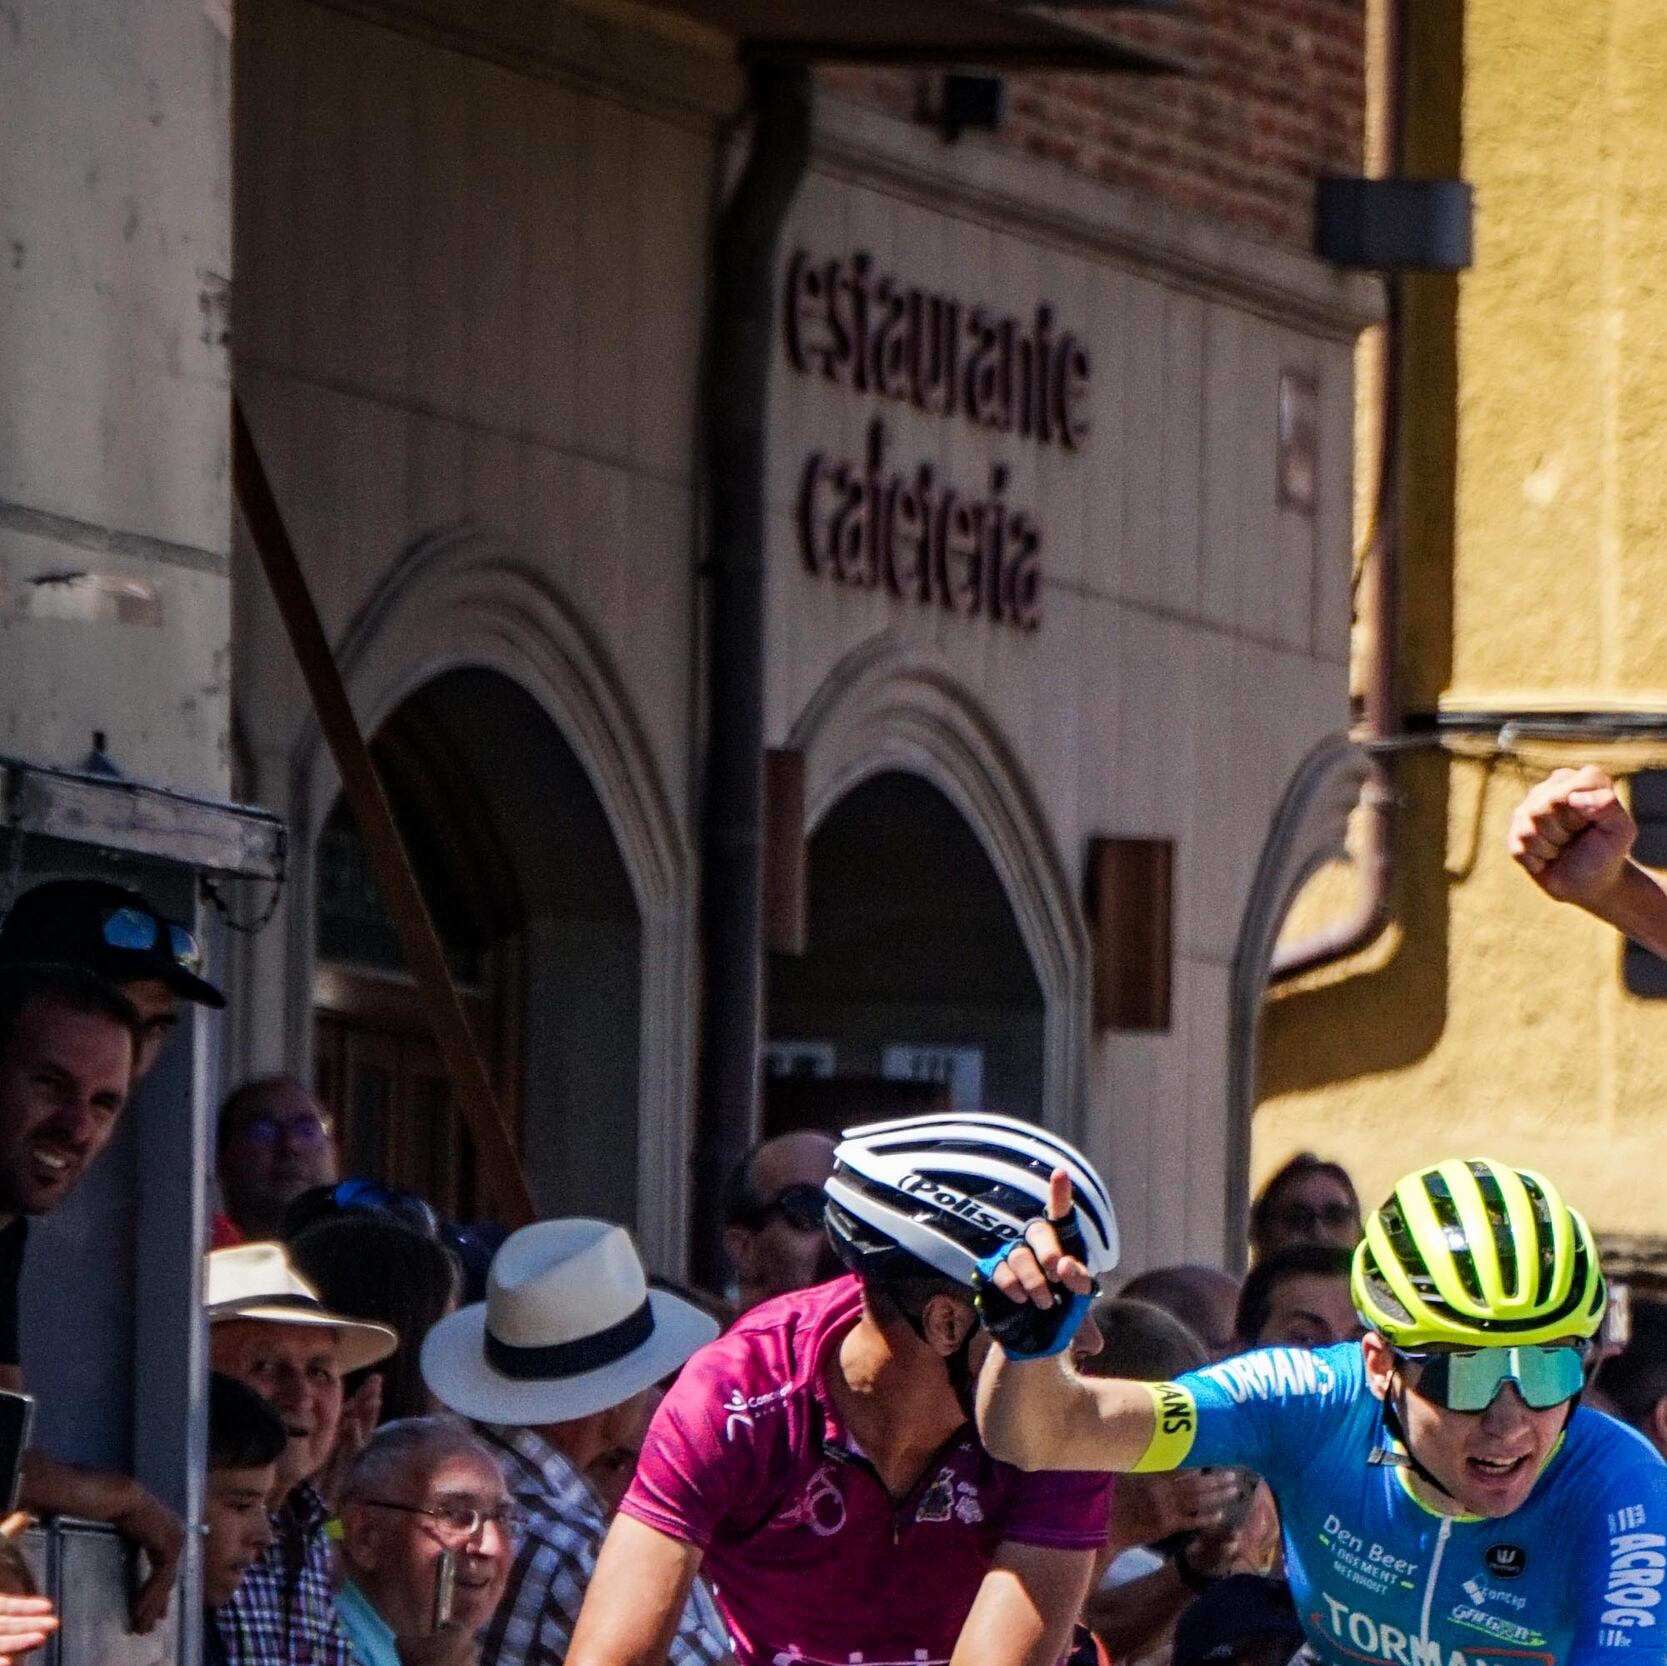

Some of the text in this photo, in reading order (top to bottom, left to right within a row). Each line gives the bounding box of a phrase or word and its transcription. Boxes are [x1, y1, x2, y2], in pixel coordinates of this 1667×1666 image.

[1323, 1514, 1419, 1576] Den Beer
[1601, 1533, 1667, 1628] ACROG
